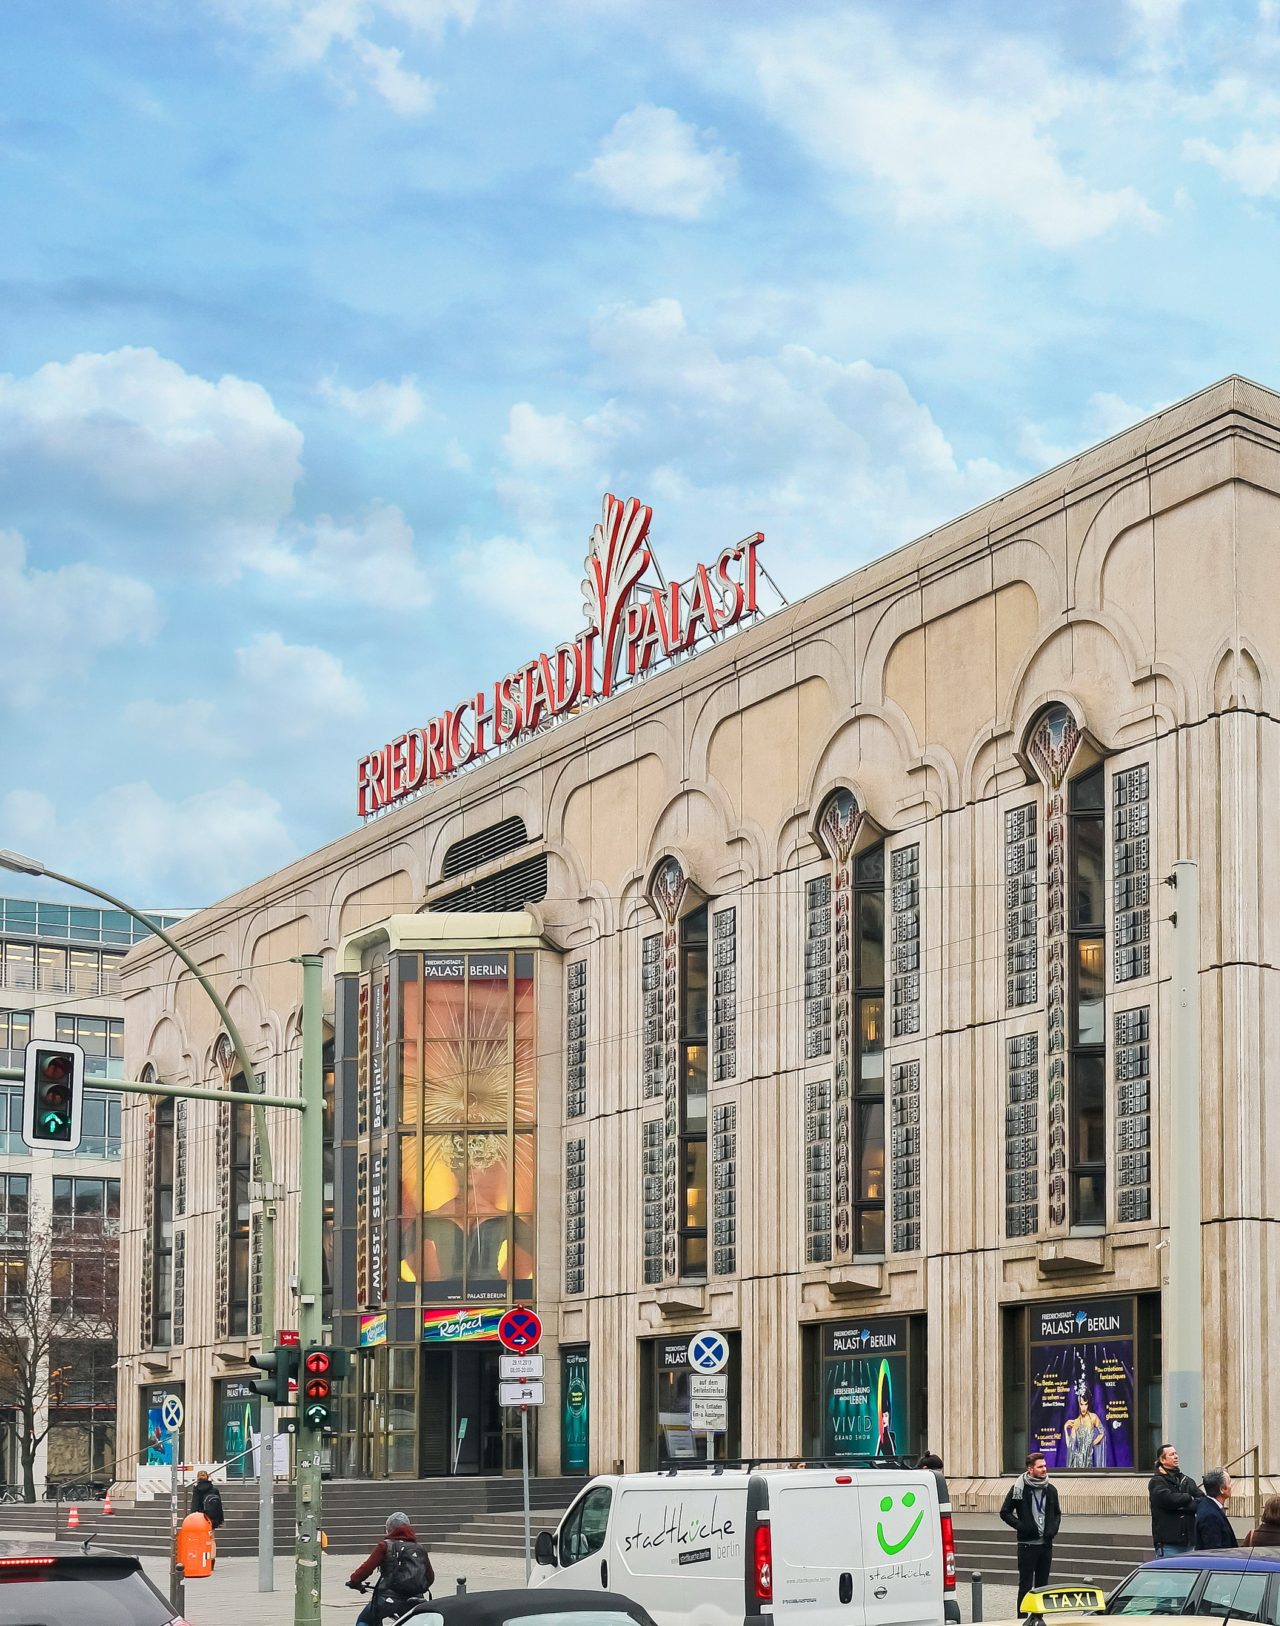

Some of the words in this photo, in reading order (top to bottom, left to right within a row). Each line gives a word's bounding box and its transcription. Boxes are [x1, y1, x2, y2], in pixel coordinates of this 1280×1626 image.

[356, 626, 598, 817] FRIEDRICHSTADT
[625, 532, 765, 675] PALAST
[425, 965, 465, 977] PALAST
[470, 965, 507, 976] BERLIN
[372, 1160, 381, 1178] in
[372, 1185, 381, 1218] SEE
[438, 1315, 482, 1338] Respect
[1042, 1320, 1075, 1335] PALAST
[1088, 1316, 1120, 1331] BERLIN
[833, 1337, 860, 1351] PALAST
[870, 1334, 896, 1348] BERLIN
[665, 1352, 688, 1364] PALAST
[850, 1395, 868, 1405] LEBEN
[833, 1416, 872, 1432] VIVID
[625, 1495, 735, 1552] stadtküche
[717, 1540, 740, 1560] berlin
[869, 1563, 931, 1581] stadtküche
[1049, 1593, 1092, 1608] TAXI
